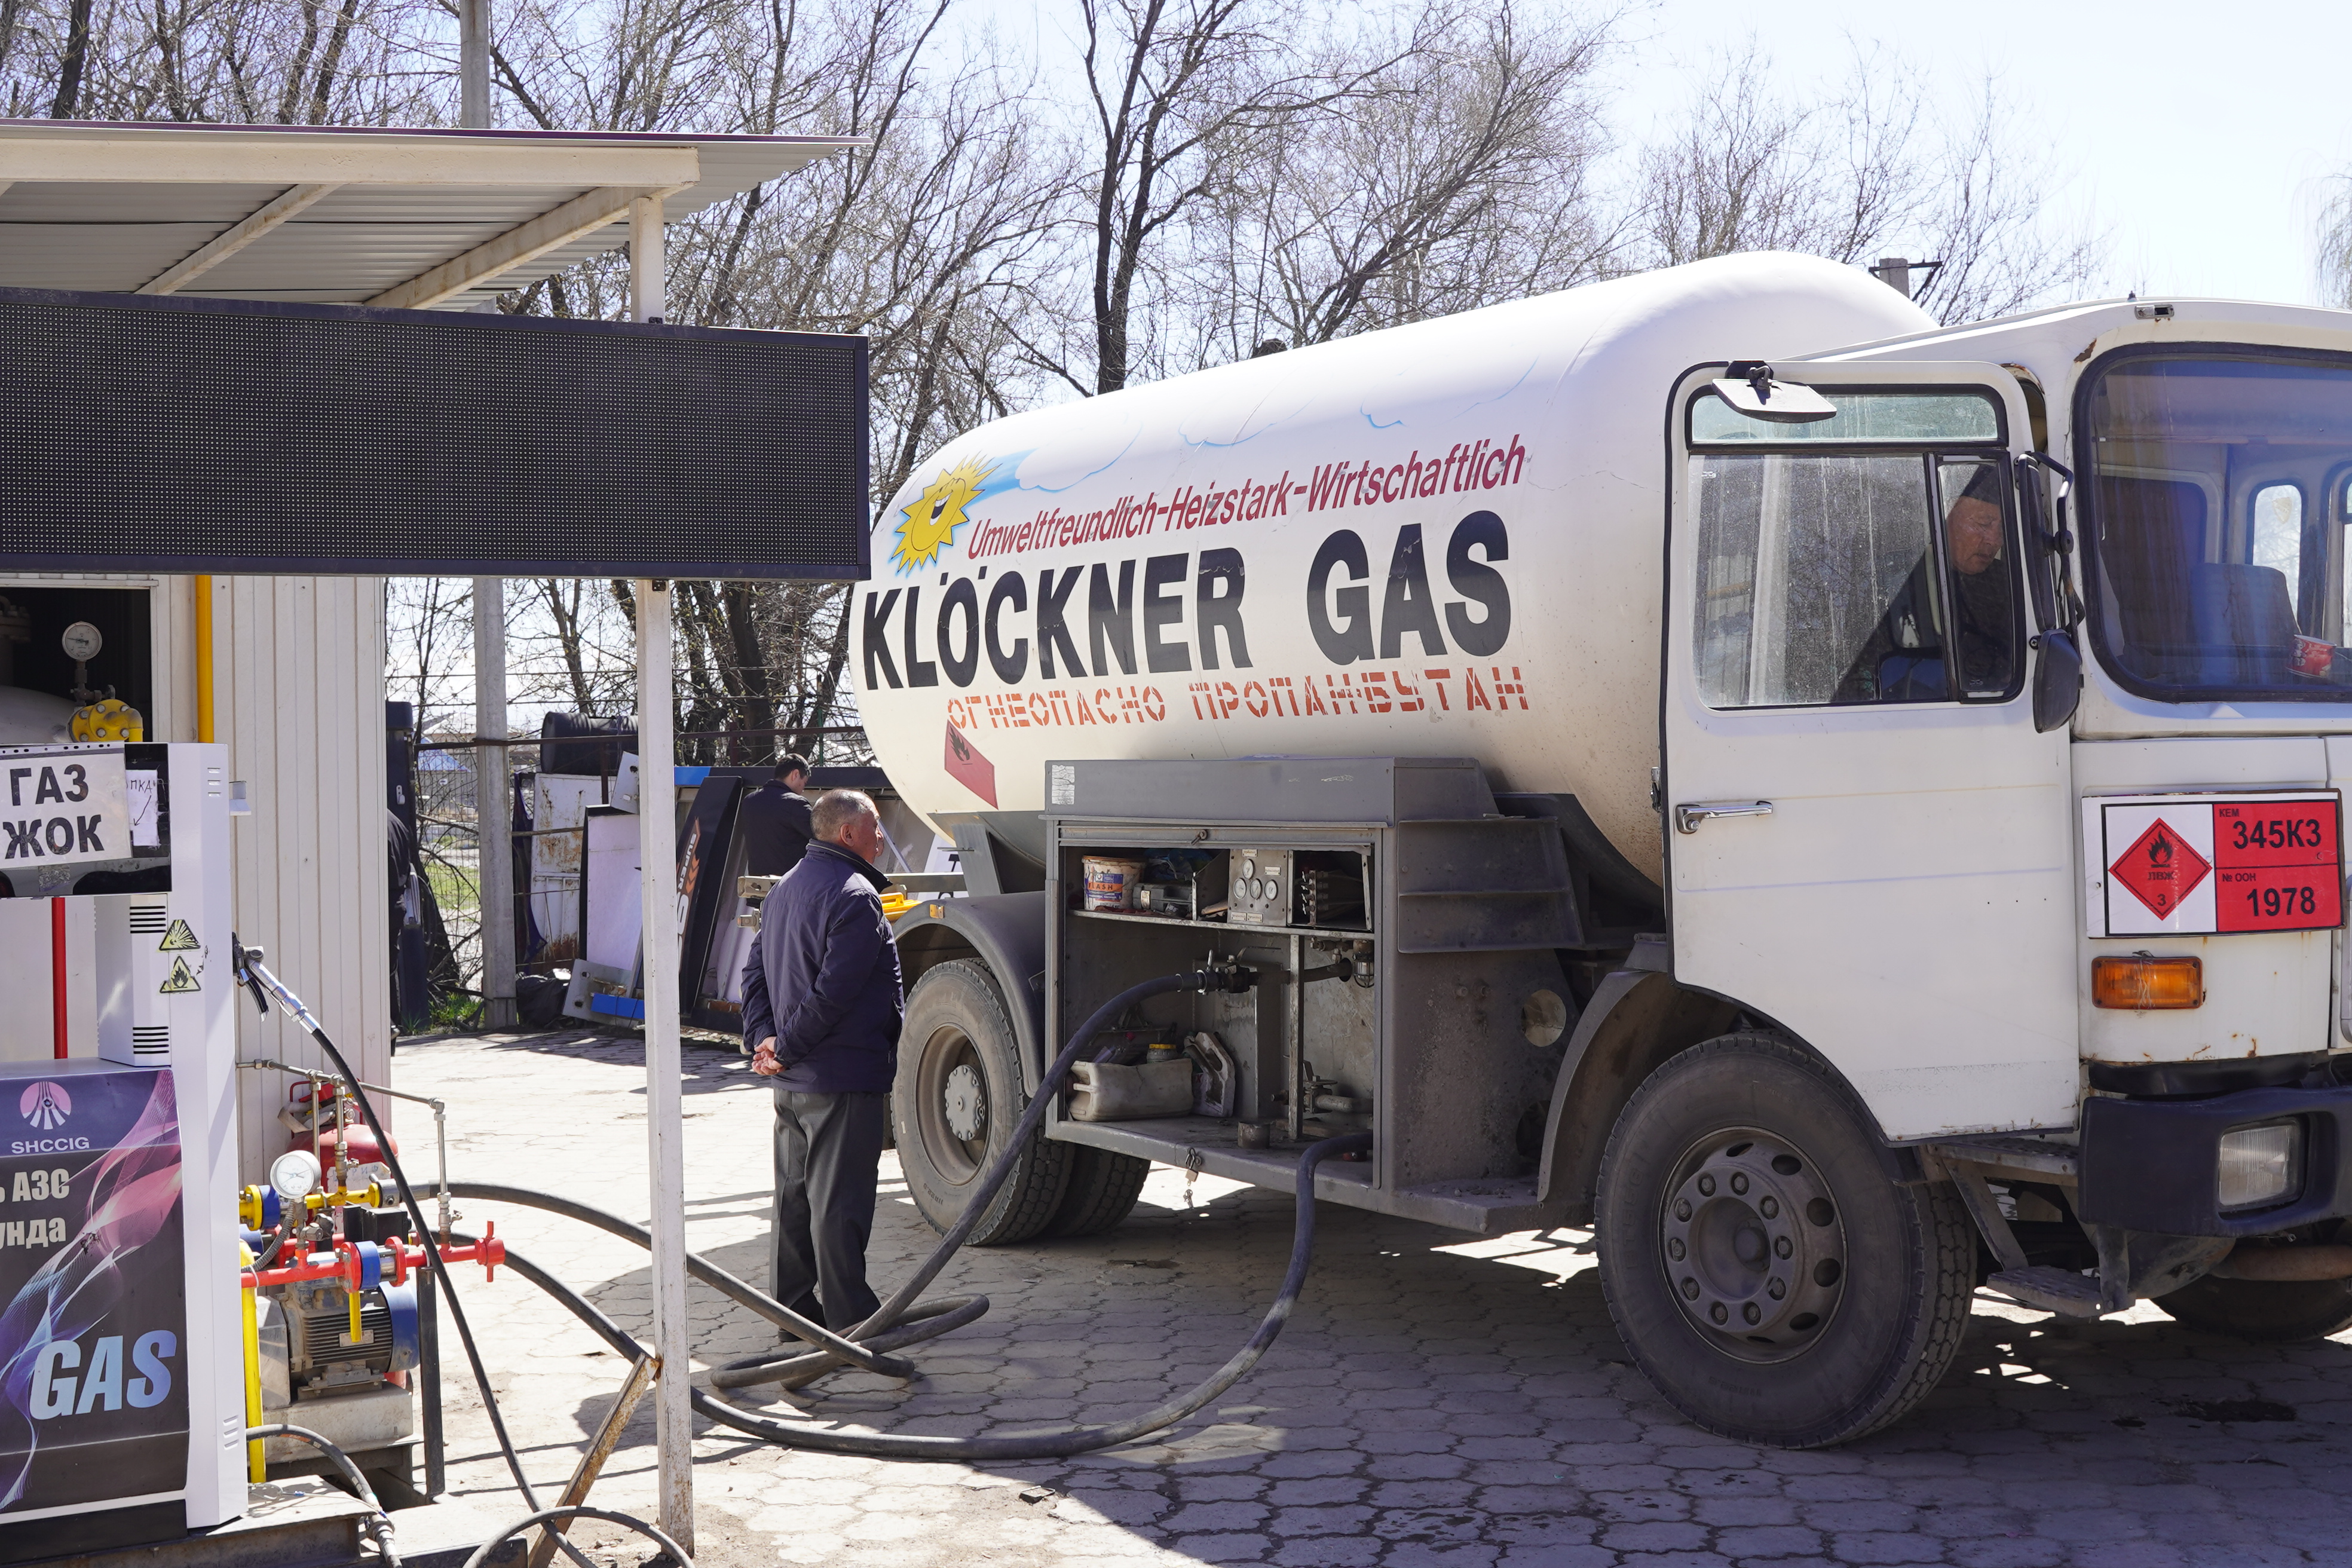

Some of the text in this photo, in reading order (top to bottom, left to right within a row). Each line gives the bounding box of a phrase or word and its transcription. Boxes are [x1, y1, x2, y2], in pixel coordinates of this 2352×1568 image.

[967, 433, 1526, 560] Umweltfreundlich-Heizstark-Wirtschaftlich
[862, 509, 1511, 690] KLÖCKNER GAS
[947, 685, 1166, 730] ОГНЕОПАСНО
[10, 764, 89, 806] ГАЗ
[2219, 808, 2240, 817] КЕМ
[2, 814, 104, 859] ЖОК
[677, 832, 697, 890] SUPER
[2235, 873, 2256, 882] ООН
[2157, 893, 2167, 906] 3
[2246, 887, 2316, 917] 1978
[11, 1137, 90, 1154] SHCCIG
[12, 1168, 70, 1202] АЗС
[29, 1330, 177, 1420] GAS
